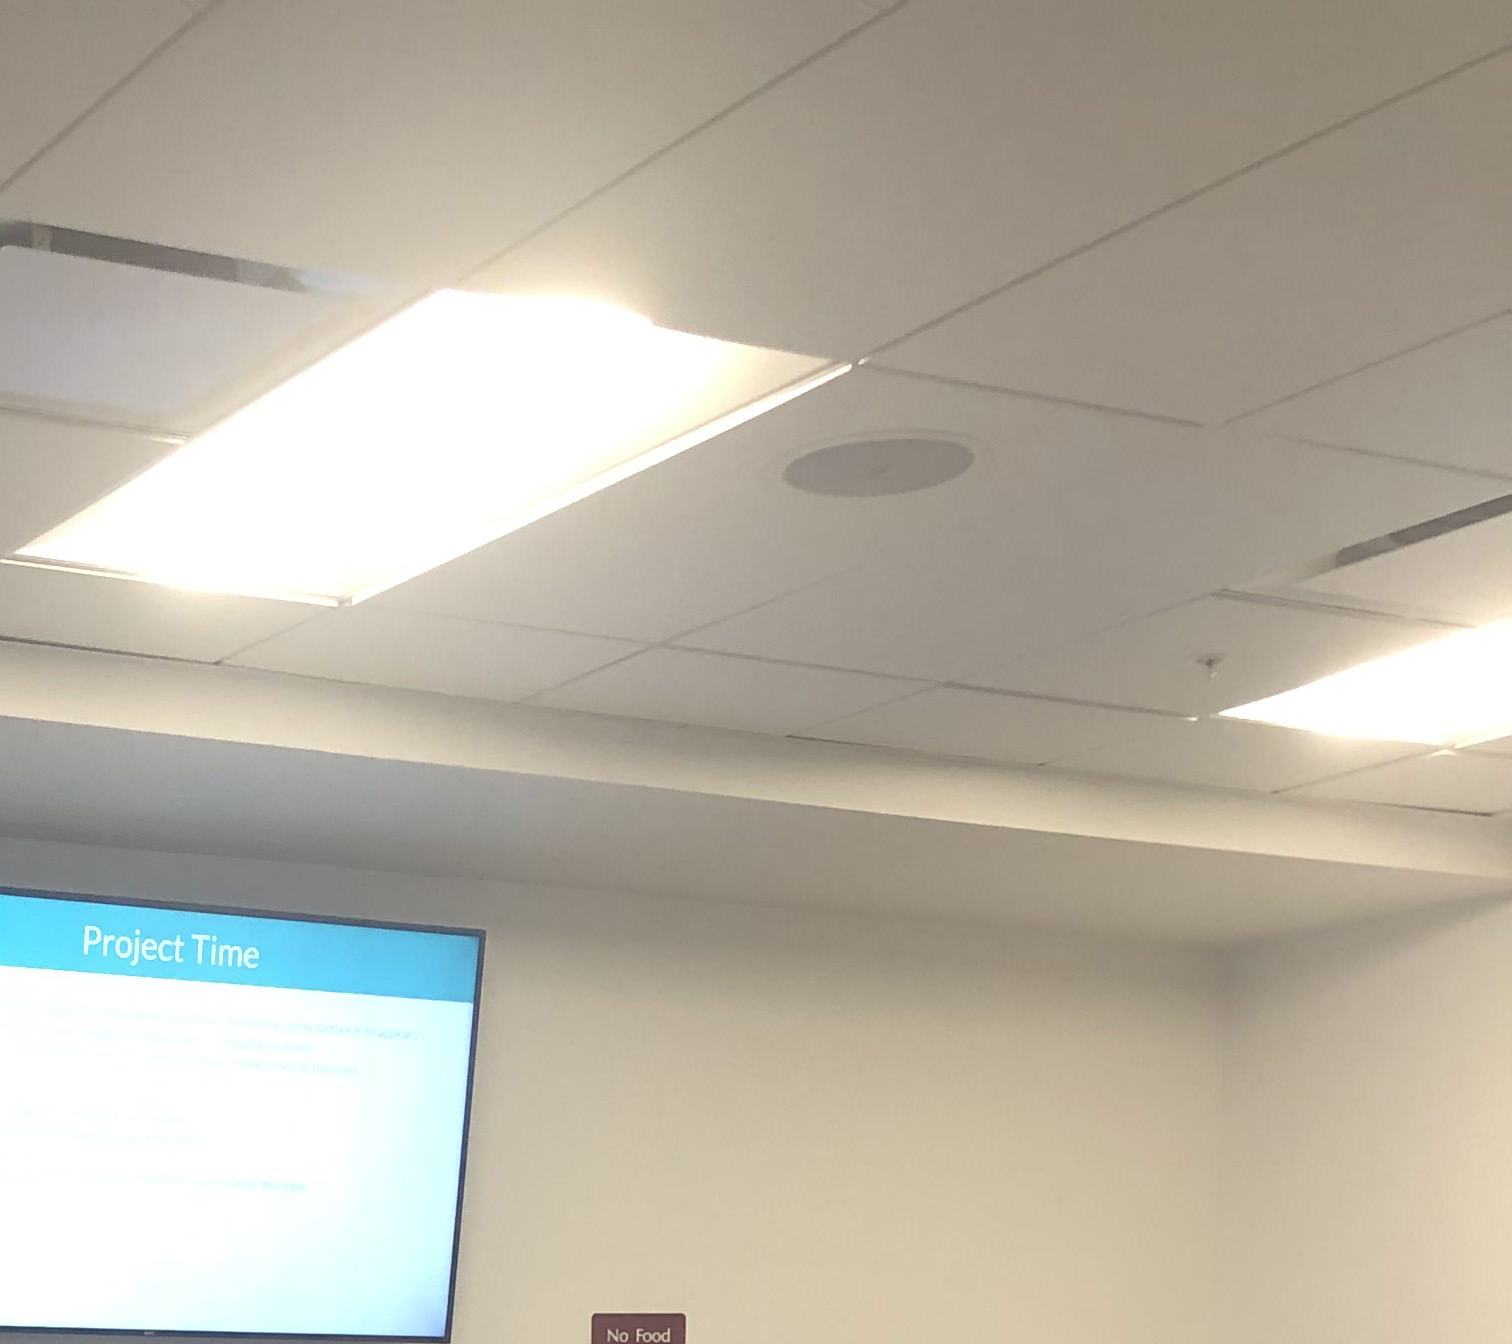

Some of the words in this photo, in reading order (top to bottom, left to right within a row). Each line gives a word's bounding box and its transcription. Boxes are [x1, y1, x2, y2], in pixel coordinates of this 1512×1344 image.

[82, 924, 185, 967] Project
[191, 933, 260, 969] Time
[607, 1329, 628, 1343] No
[636, 1328, 671, 1343] Food
